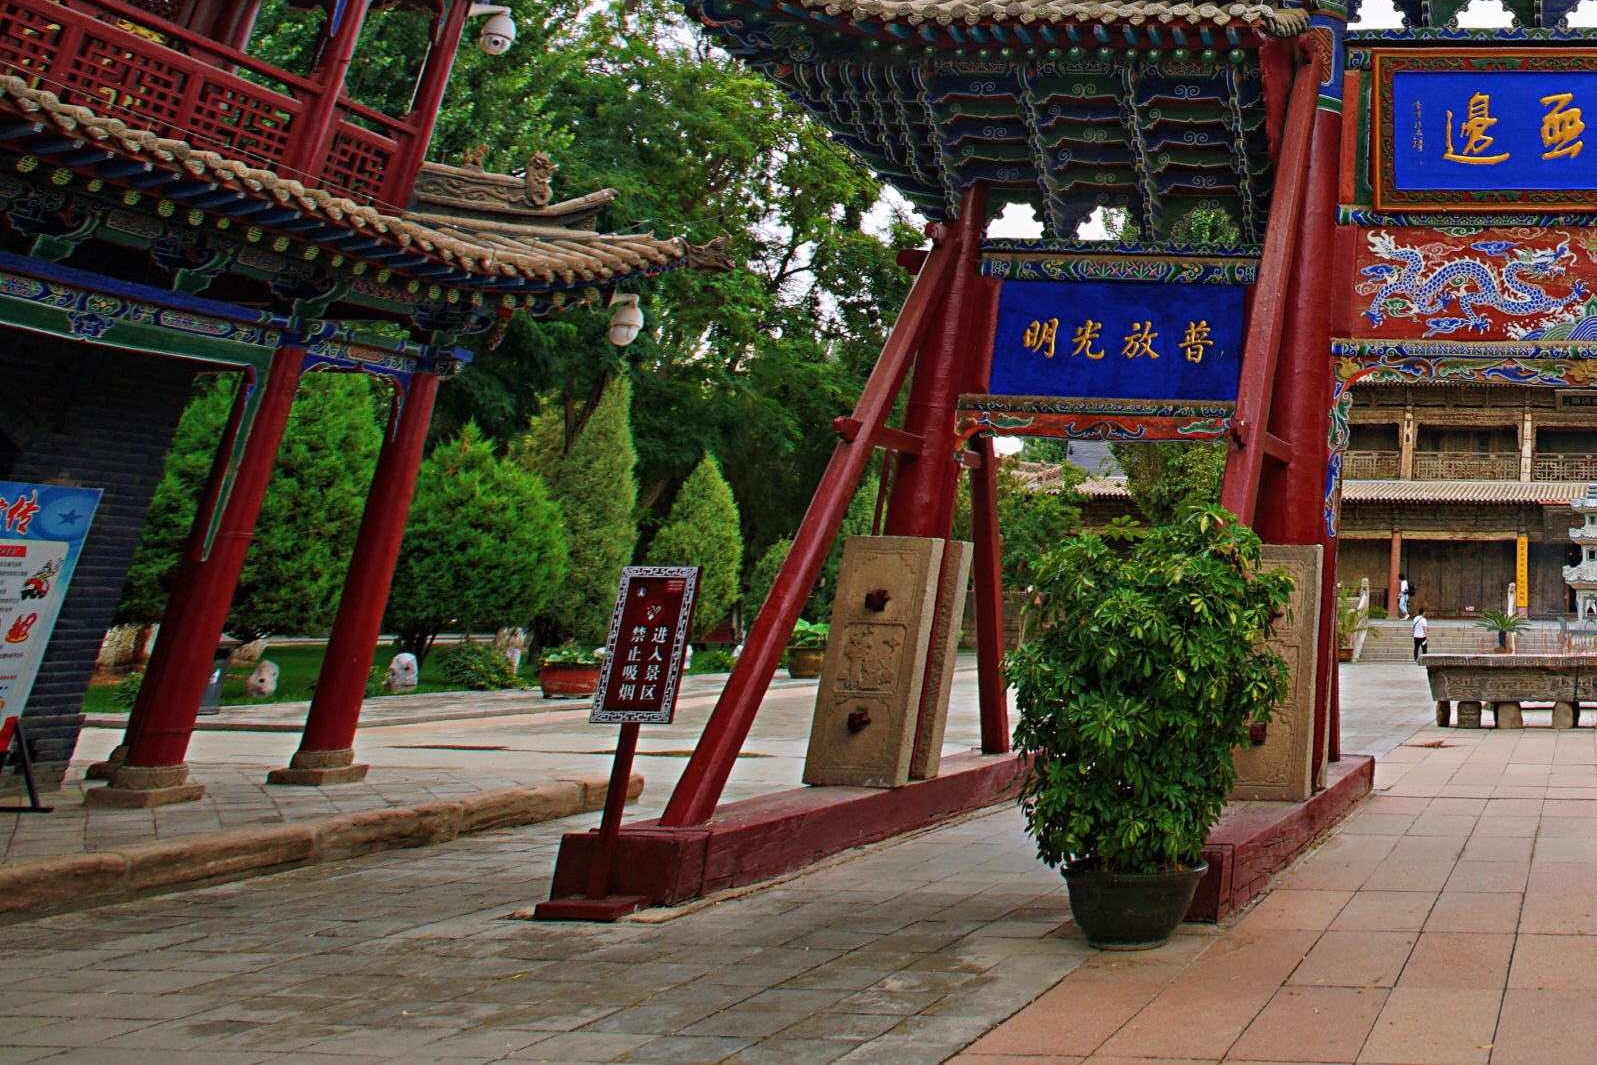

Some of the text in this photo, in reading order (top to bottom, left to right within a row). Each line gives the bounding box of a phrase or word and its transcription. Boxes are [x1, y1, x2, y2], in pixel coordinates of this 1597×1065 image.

[1023, 317, 1213, 363] 普放光明
[617, 625, 647, 701] 禁止吸烟
[639, 626, 668, 701] 进入景区
